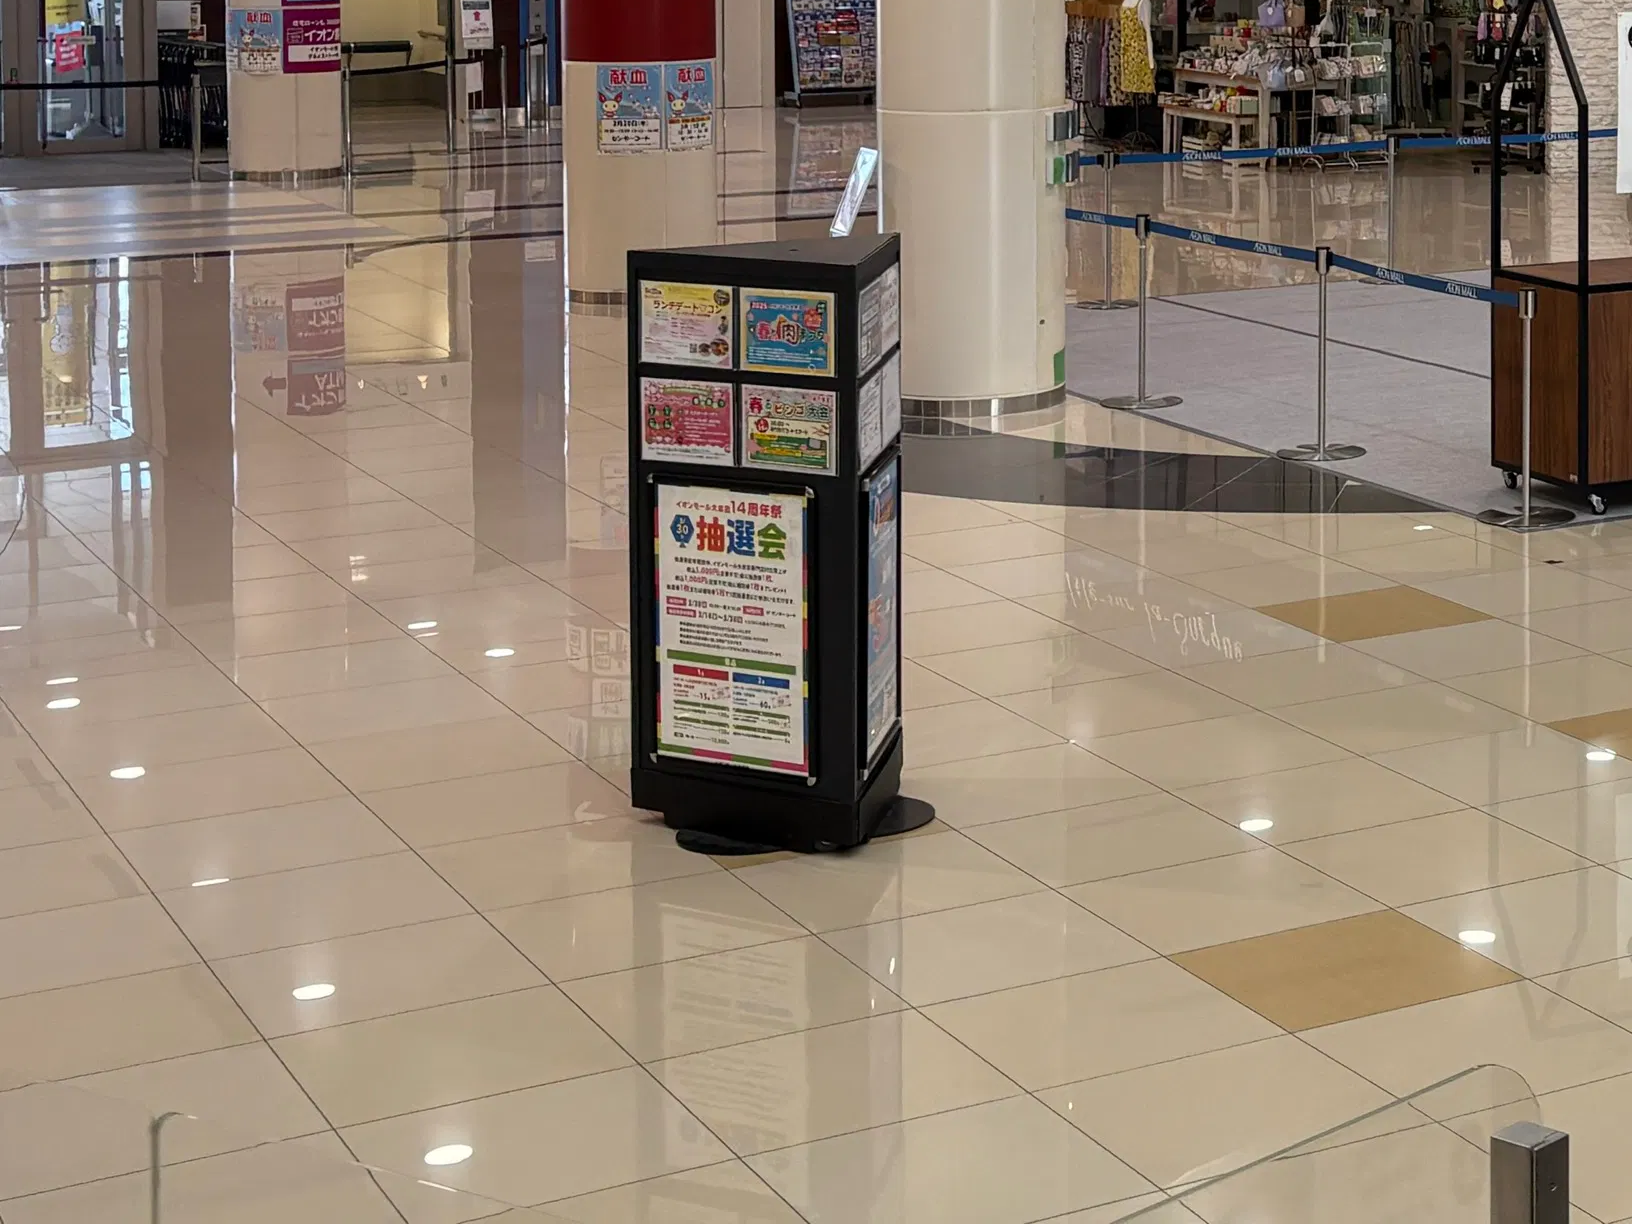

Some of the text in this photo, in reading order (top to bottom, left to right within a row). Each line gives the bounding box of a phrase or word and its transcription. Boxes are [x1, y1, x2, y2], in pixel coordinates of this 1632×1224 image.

[610, 68, 648, 85] 献血
[678, 67, 706, 83] 献血
[696, 515, 787, 560] 抽選会
